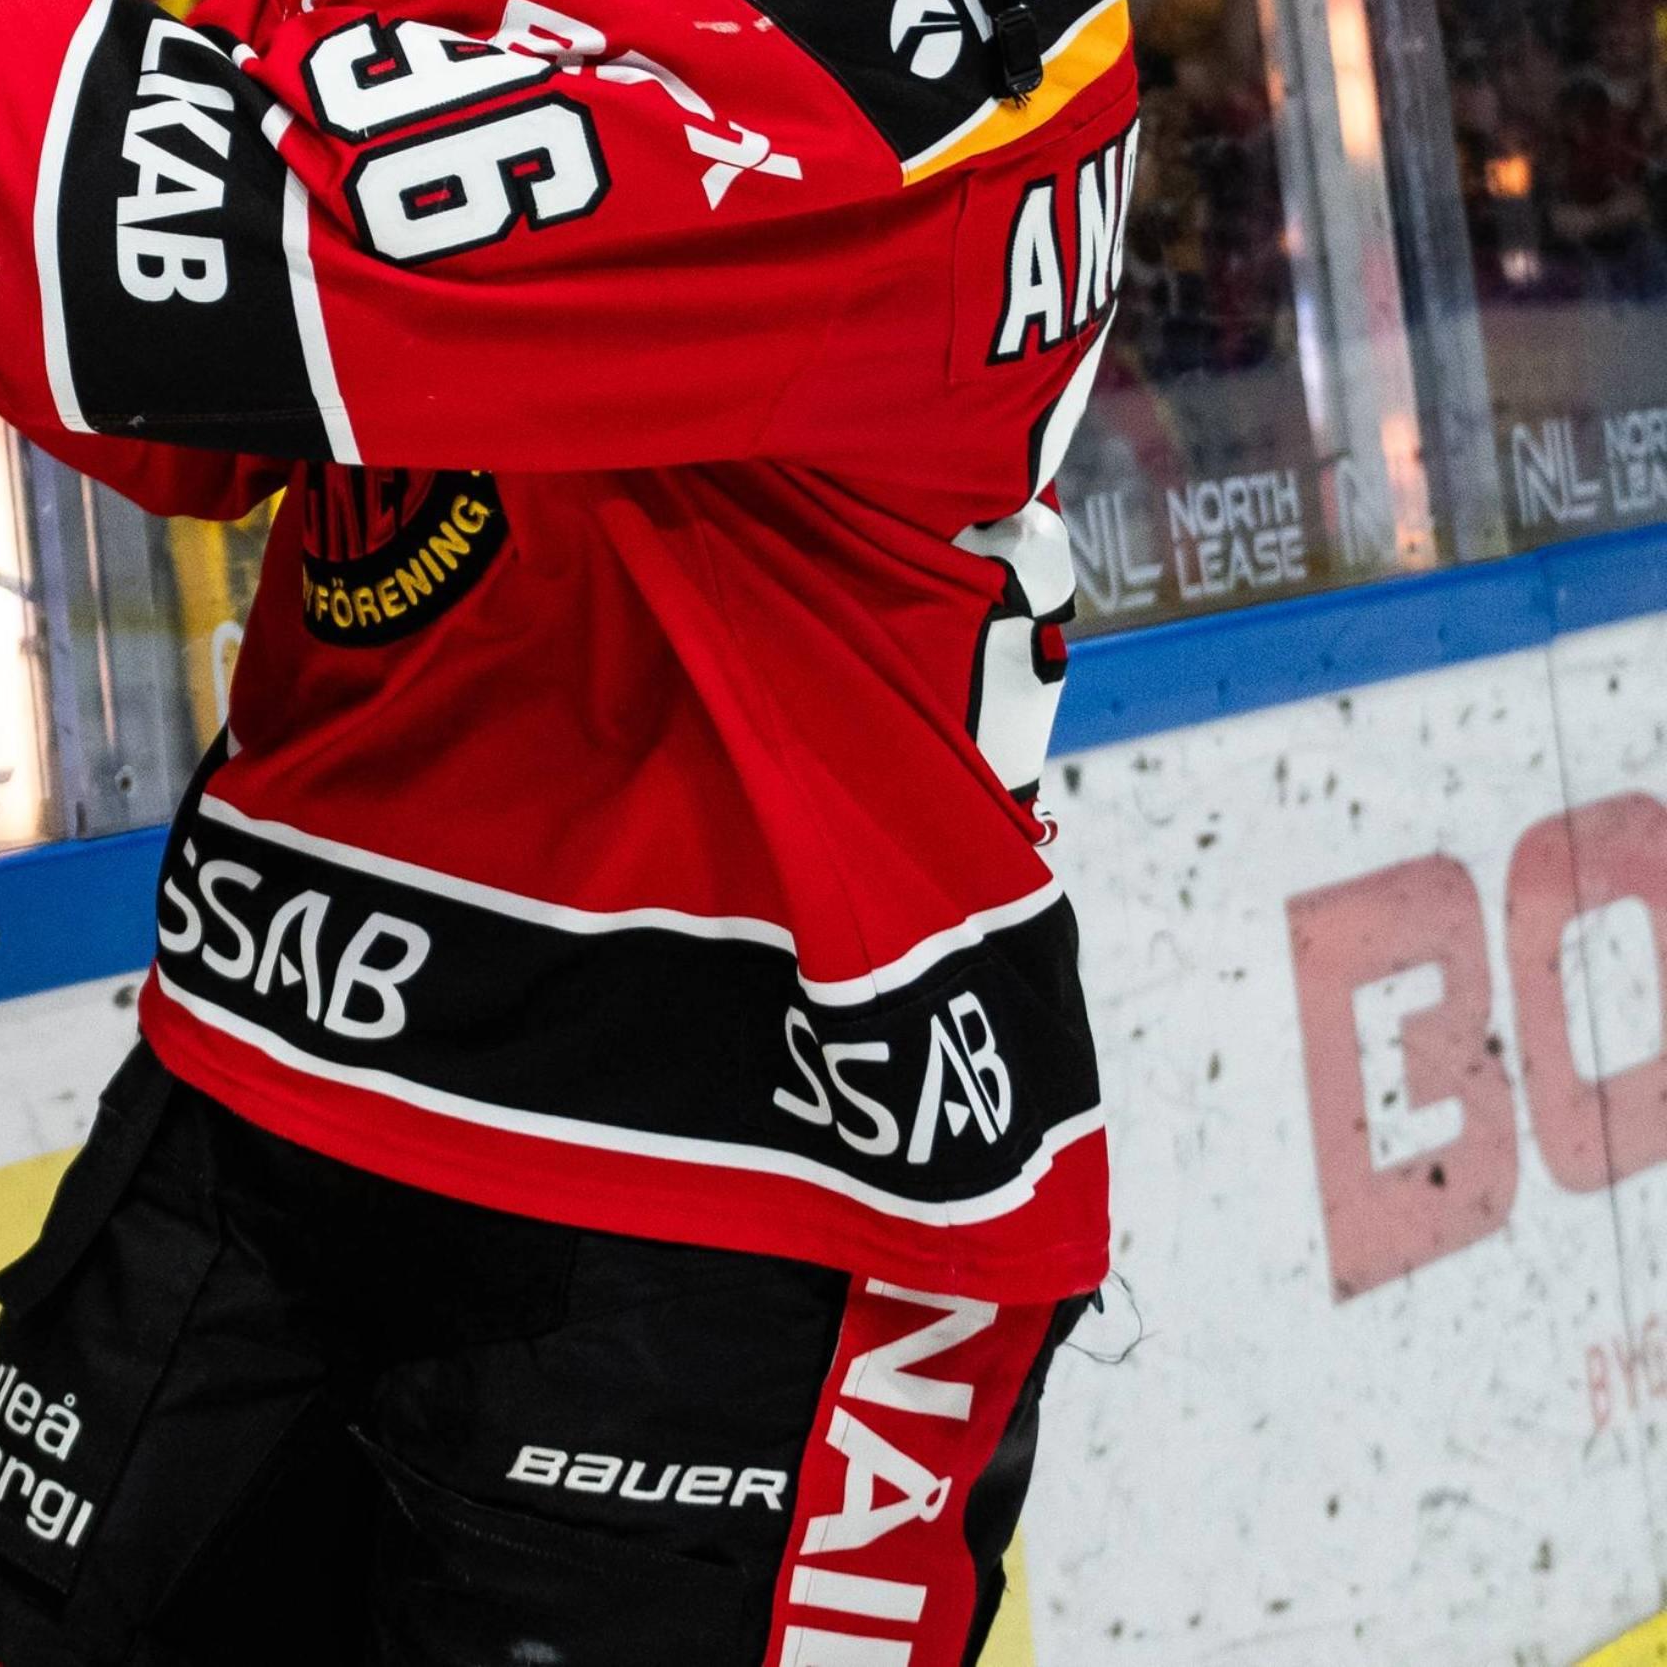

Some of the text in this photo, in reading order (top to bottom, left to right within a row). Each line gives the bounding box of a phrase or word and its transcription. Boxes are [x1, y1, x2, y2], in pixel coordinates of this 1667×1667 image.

[114, 18, 235, 304] LKAB
[1167, 469, 1302, 540] NORTH
[1173, 526, 1308, 601] LEASE
[772, 990, 1011, 1164] SSAB
